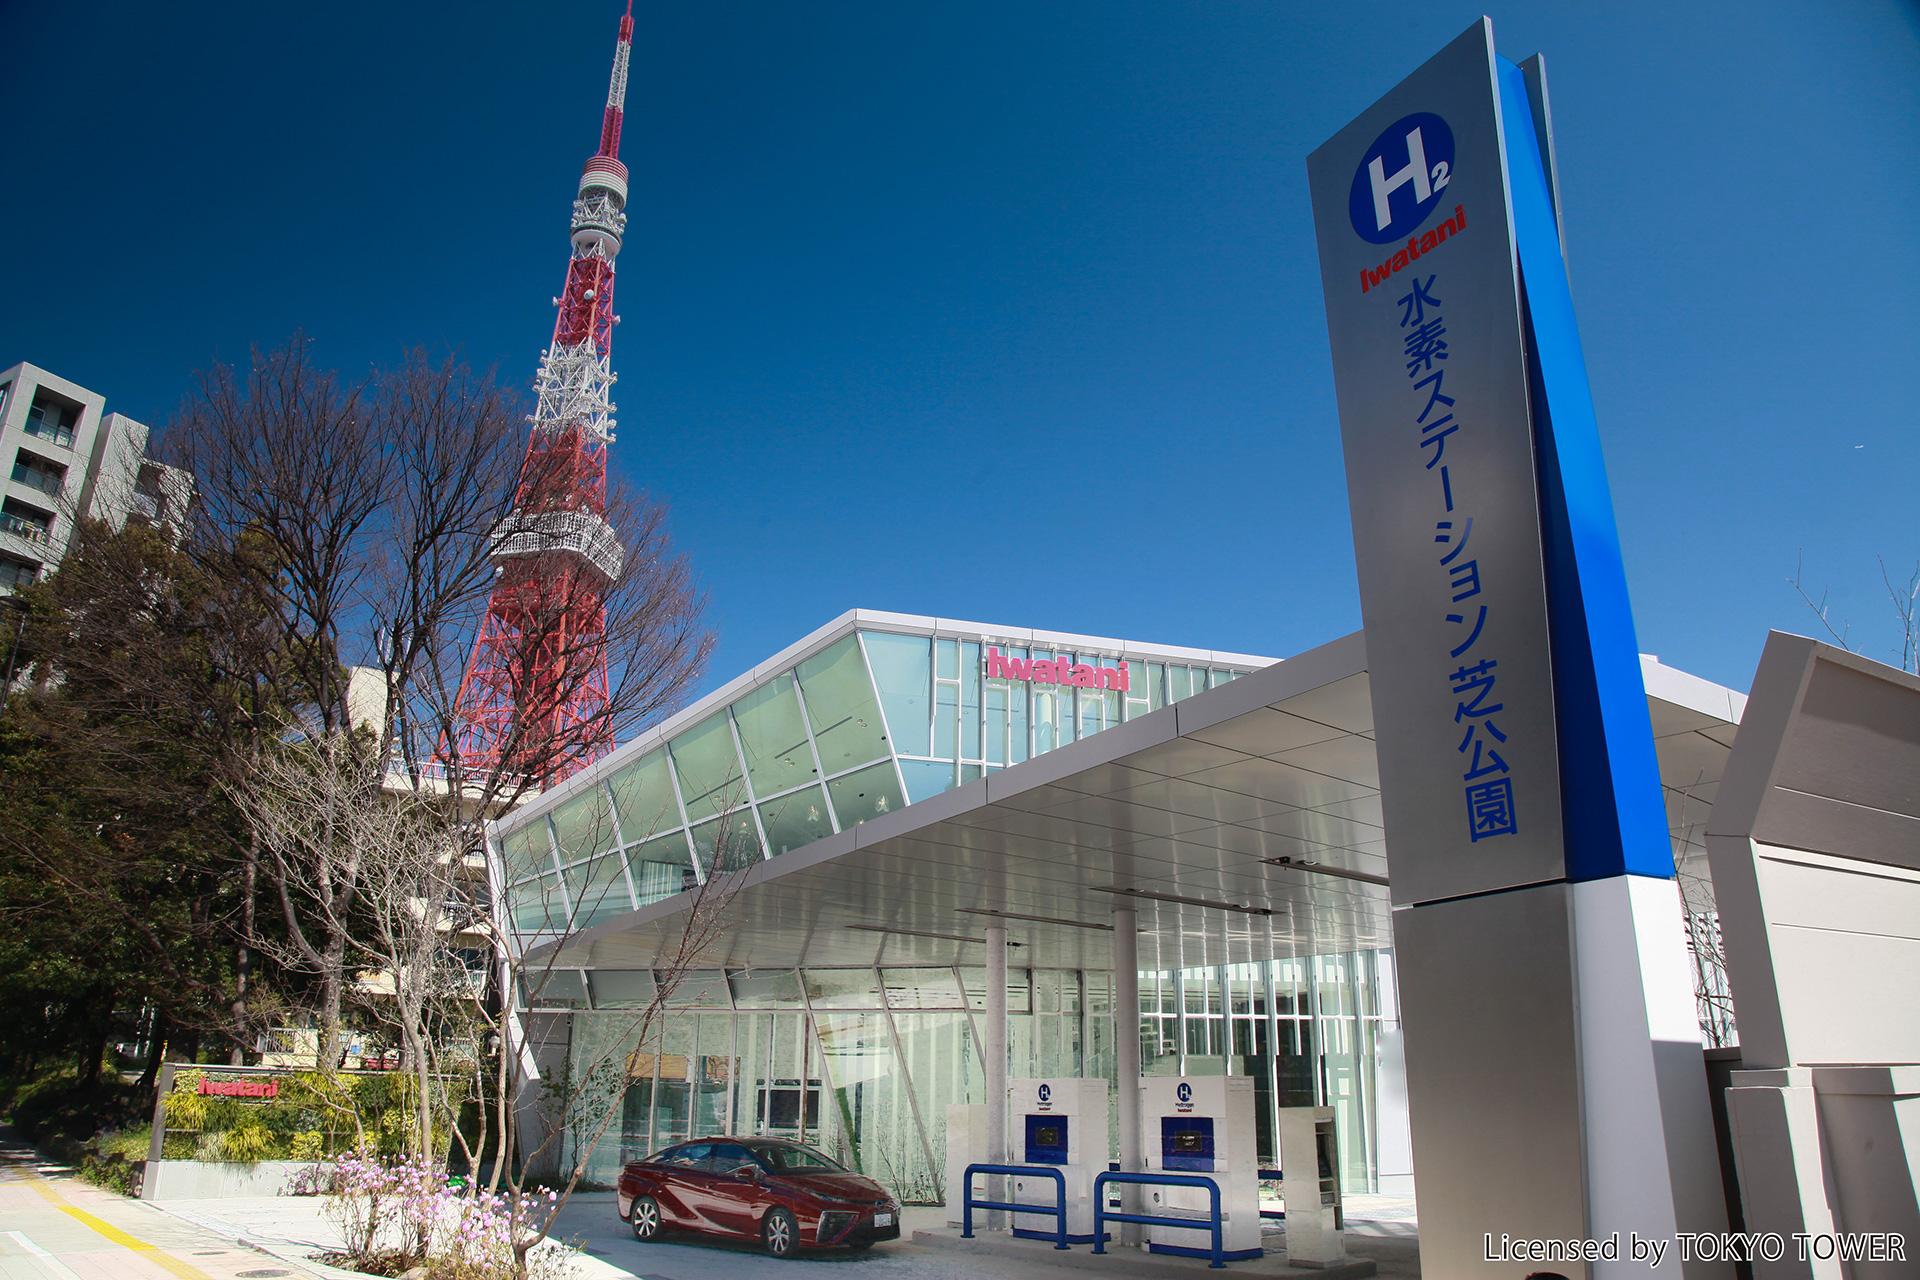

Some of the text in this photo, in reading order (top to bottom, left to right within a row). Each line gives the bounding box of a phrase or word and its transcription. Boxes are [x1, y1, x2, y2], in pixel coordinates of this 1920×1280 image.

[1368, 126, 1451, 232] H2
[1360, 203, 1468, 294] Iwatani
[1396, 273, 1518, 843] 水素ステーション芝公園
[988, 646, 1131, 692] Iwatani
[197, 1077, 279, 1097] Iwatani
